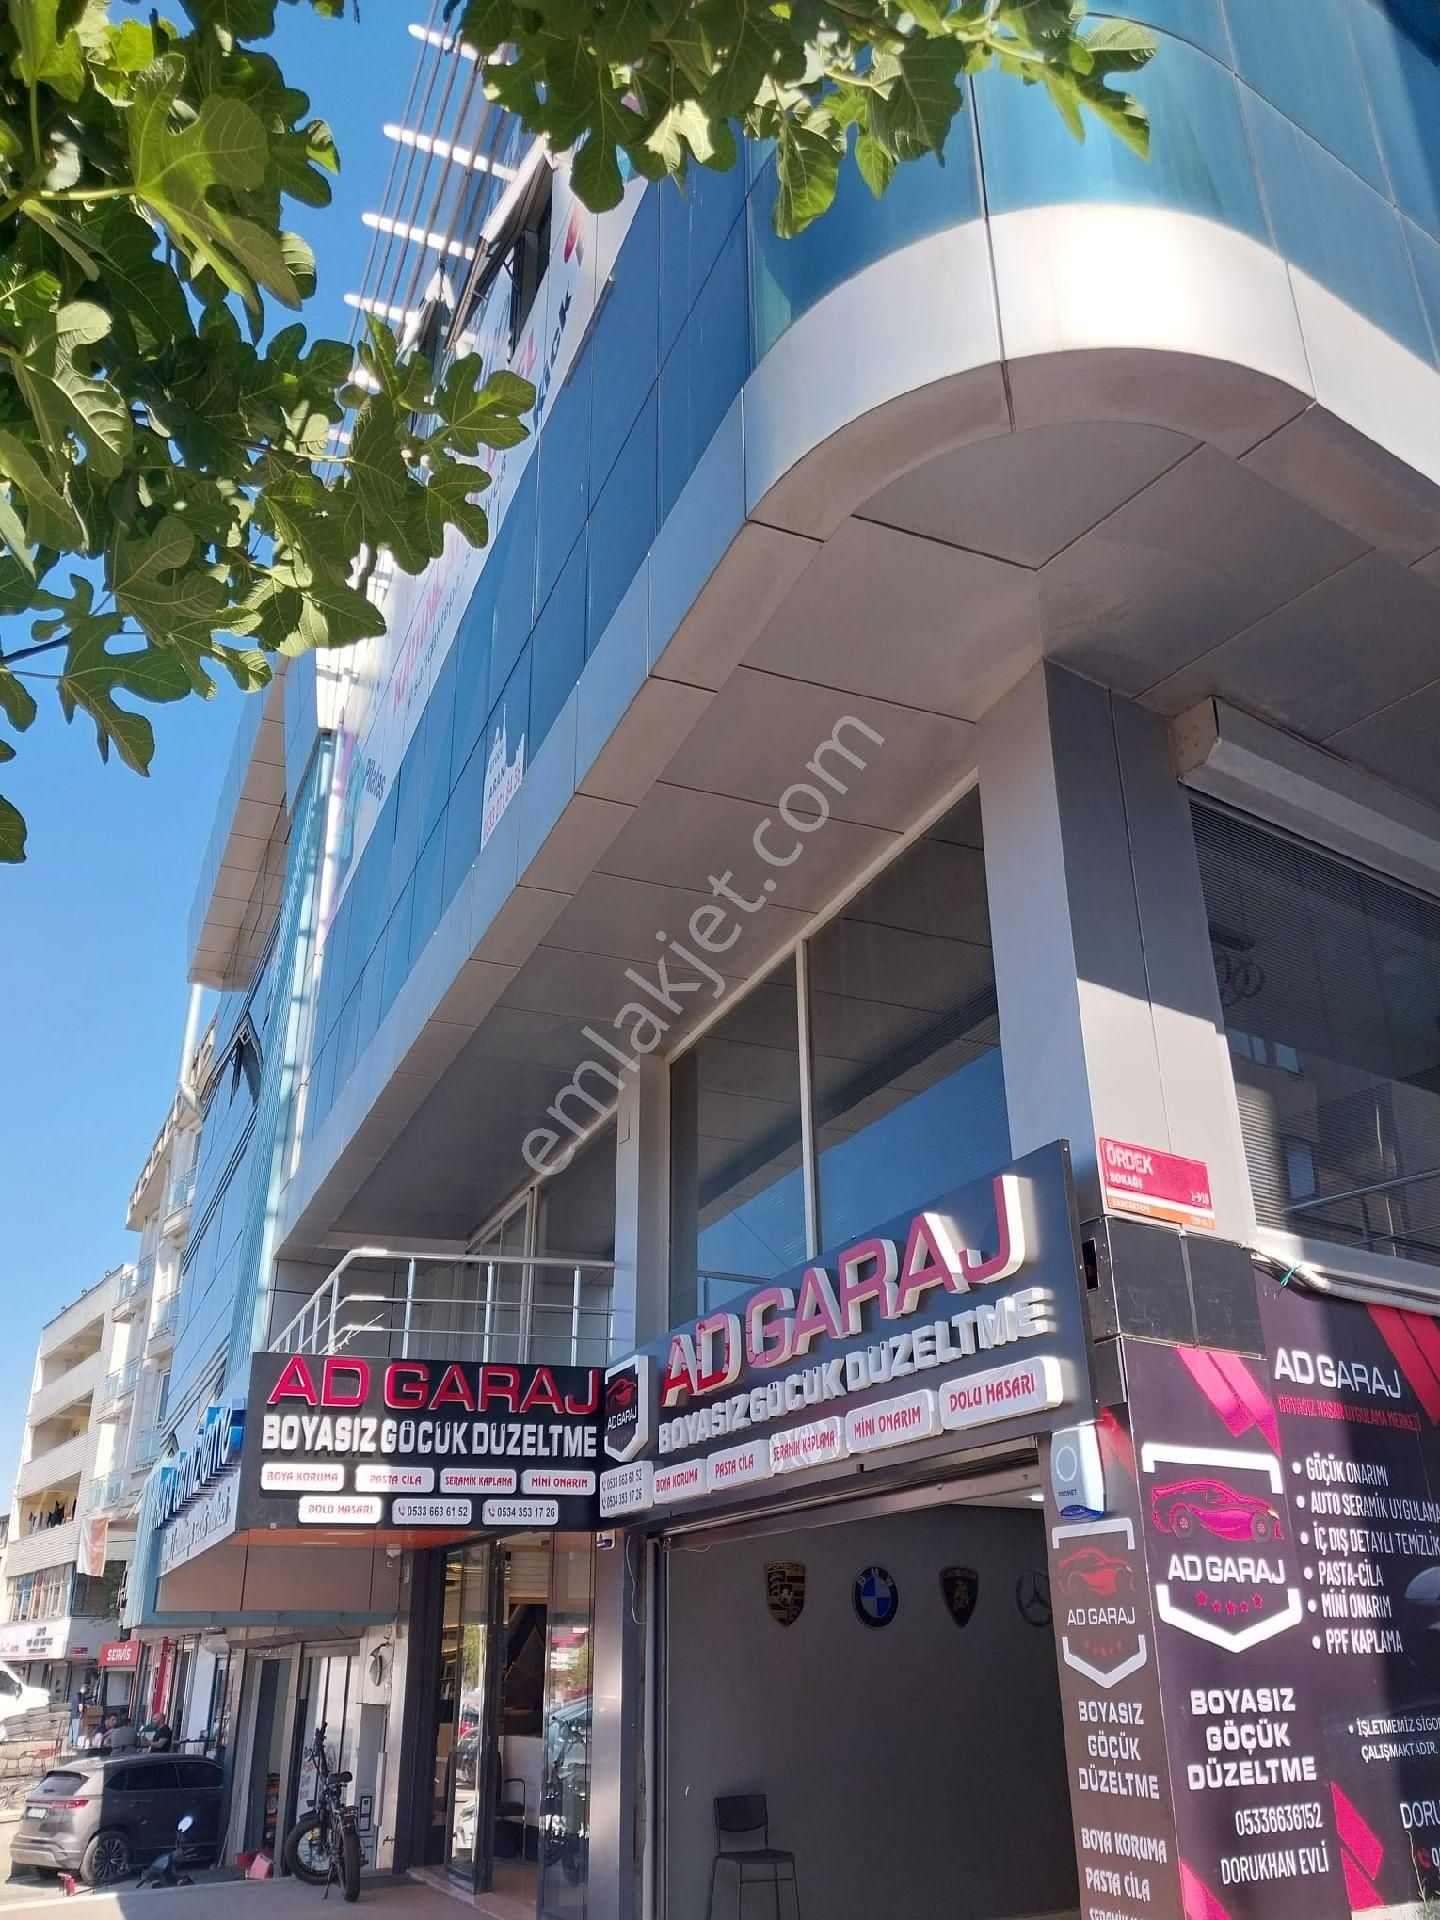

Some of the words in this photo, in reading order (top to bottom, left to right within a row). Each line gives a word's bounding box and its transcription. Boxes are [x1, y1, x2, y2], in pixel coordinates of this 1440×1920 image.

[1105, 1142, 1154, 1175] ÖRDEK
[661, 1313, 742, 1407] AD
[745, 1175, 1025, 1368] GARAJ
[267, 1355, 370, 1407] AD
[384, 1362, 599, 1415] GARAJ
[658, 1394, 752, 1454] BOYASIZ
[750, 1358, 847, 1423] GÖÇÜK
[846, 1287, 1050, 1392] DÜZELTME
[1274, 1347, 1315, 1385] AD
[1316, 1353, 1401, 1399] GARAJ
[950, 1391, 983, 1413] DOLU
[986, 1372, 1035, 1404] HASARI
[261, 1415, 378, 1453] BOYASIZ
[380, 1418, 469, 1455] GÖÇÜK
[471, 1421, 597, 1458] DÜZELTME
[854, 1416, 875, 1440] MİNİ
[878, 1405, 921, 1433] ONARIM
[266, 1471, 294, 1482] BOYA
[296, 1472, 339, 1482] KORUMA
[370, 1474, 398, 1485] PASTA
[401, 1473, 422, 1485] CİLA
[478, 1476, 513, 1487] KAPLAMA
[531, 1475, 551, 1487] MİNİ
[553, 1478, 588, 1489] ONARIM
[673, 1469, 698, 1488] KORUMA
[715, 1459, 737, 1479] PASTA
[739, 1453, 754, 1473] CİLA
[1305, 1452, 1346, 1486] GÖÇÜK
[1346, 1461, 1389, 1487] ONARIMI
[308, 1504, 334, 1514] DOLU
[337, 1504, 374, 1515] HASARI
[407, 1505, 427, 1517] 0533
[429, 1505, 444, 1517] 663
[446, 1505, 456, 1517] 61
[458, 1506, 468, 1517] 52
[497, 1507, 516, 1517] 0534
[518, 1507, 533, 1517] 353
[535, 1507, 543, 1517] 17
[546, 1507, 555, 1517] 26
[1310, 1491, 1341, 1516] AUTO
[1342, 1492, 1389, 1519] SERAMİK
[1390, 1498, 1440, 1524] UYGULAMA
[1313, 1521, 1328, 1556] İÇ
[1328, 1526, 1349, 1557] DIŞ
[1349, 1527, 1394, 1554] DETAYLI
[1395, 1527, 1440, 1557] TEMİZLİK
[1168, 1554, 1201, 1582] AD
[1205, 1558, 1286, 1585] GARAJ
[1318, 1558, 1385, 1588] PASTA-CİLA
[1066, 1607, 1087, 1627] AD
[1087, 1606, 1136, 1626] GARAJ
[1321, 1587, 1349, 1619] MİNİ
[1349, 1592, 1393, 1619] ONARIM
[106, 1644, 132, 1661] SERVİS
[1325, 1628, 1350, 1655] PPF
[1350, 1628, 1404, 1655] KAPLAMA
[1078, 1700, 1145, 1726] BOYASIZ
[1190, 1687, 1296, 1716] BOYASIZ
[1205, 1719, 1291, 1756] GÖÇÜK
[1356, 1715, 1415, 1738] İŞLETMEMİZ
[1087, 1730, 1142, 1765] GÖÇÜK
[1361, 1741, 1439, 1764] ÇALIŞMAKTADIR.
[1078, 1766, 1161, 1801] DÜZELTME
[1186, 1756, 1317, 1791] DÜZELTME
[1235, 1802, 1324, 1837] 05336636152
[1080, 1827, 1112, 1855] BOYA
[1113, 1833, 1168, 1864] KORUMA
[1220, 1850, 1297, 1886] DORUKHAN
[1297, 1839, 1329, 1876] EVLİ
[1085, 1866, 1122, 1897] PASTA
[1123, 1869, 1151, 1903] CİLA
